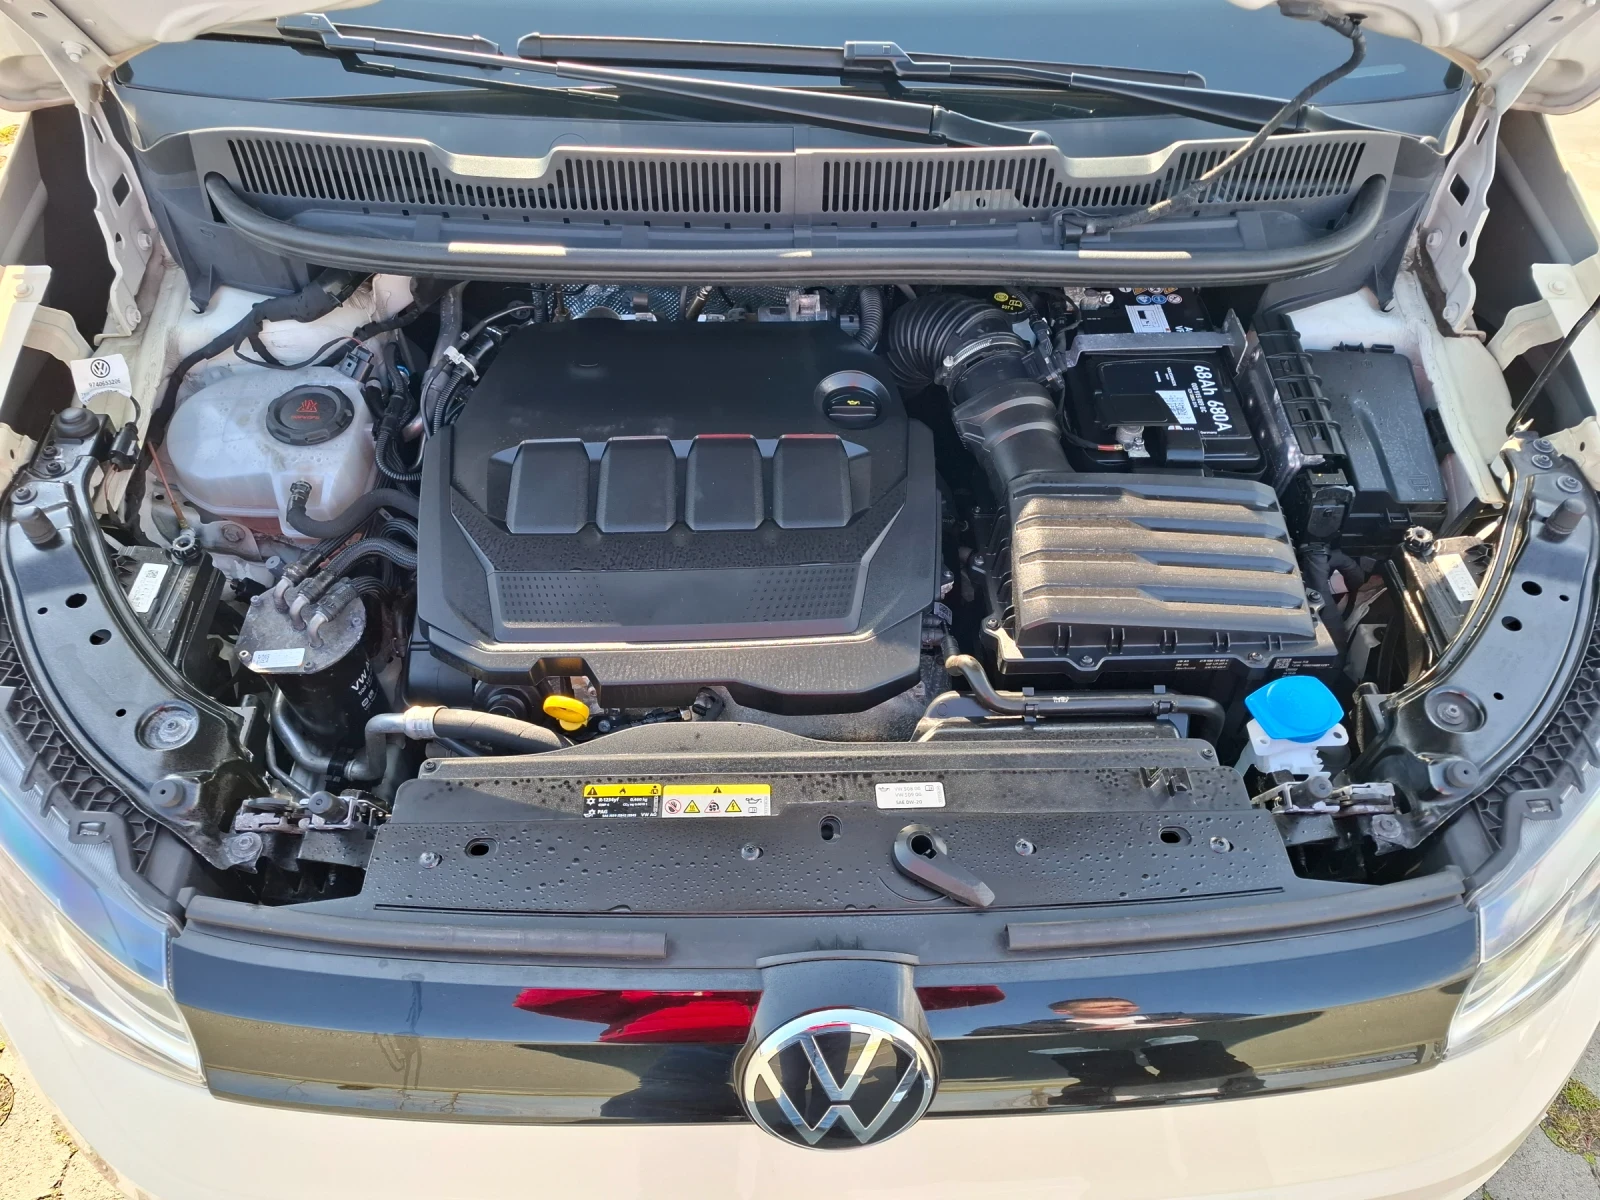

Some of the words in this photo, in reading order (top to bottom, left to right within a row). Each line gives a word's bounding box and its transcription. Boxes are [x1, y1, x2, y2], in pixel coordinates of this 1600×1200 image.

[1193, 365, 1218, 396] 68Ah
[1207, 400, 1232, 432] 680A
[351, 669, 367, 691] VW
